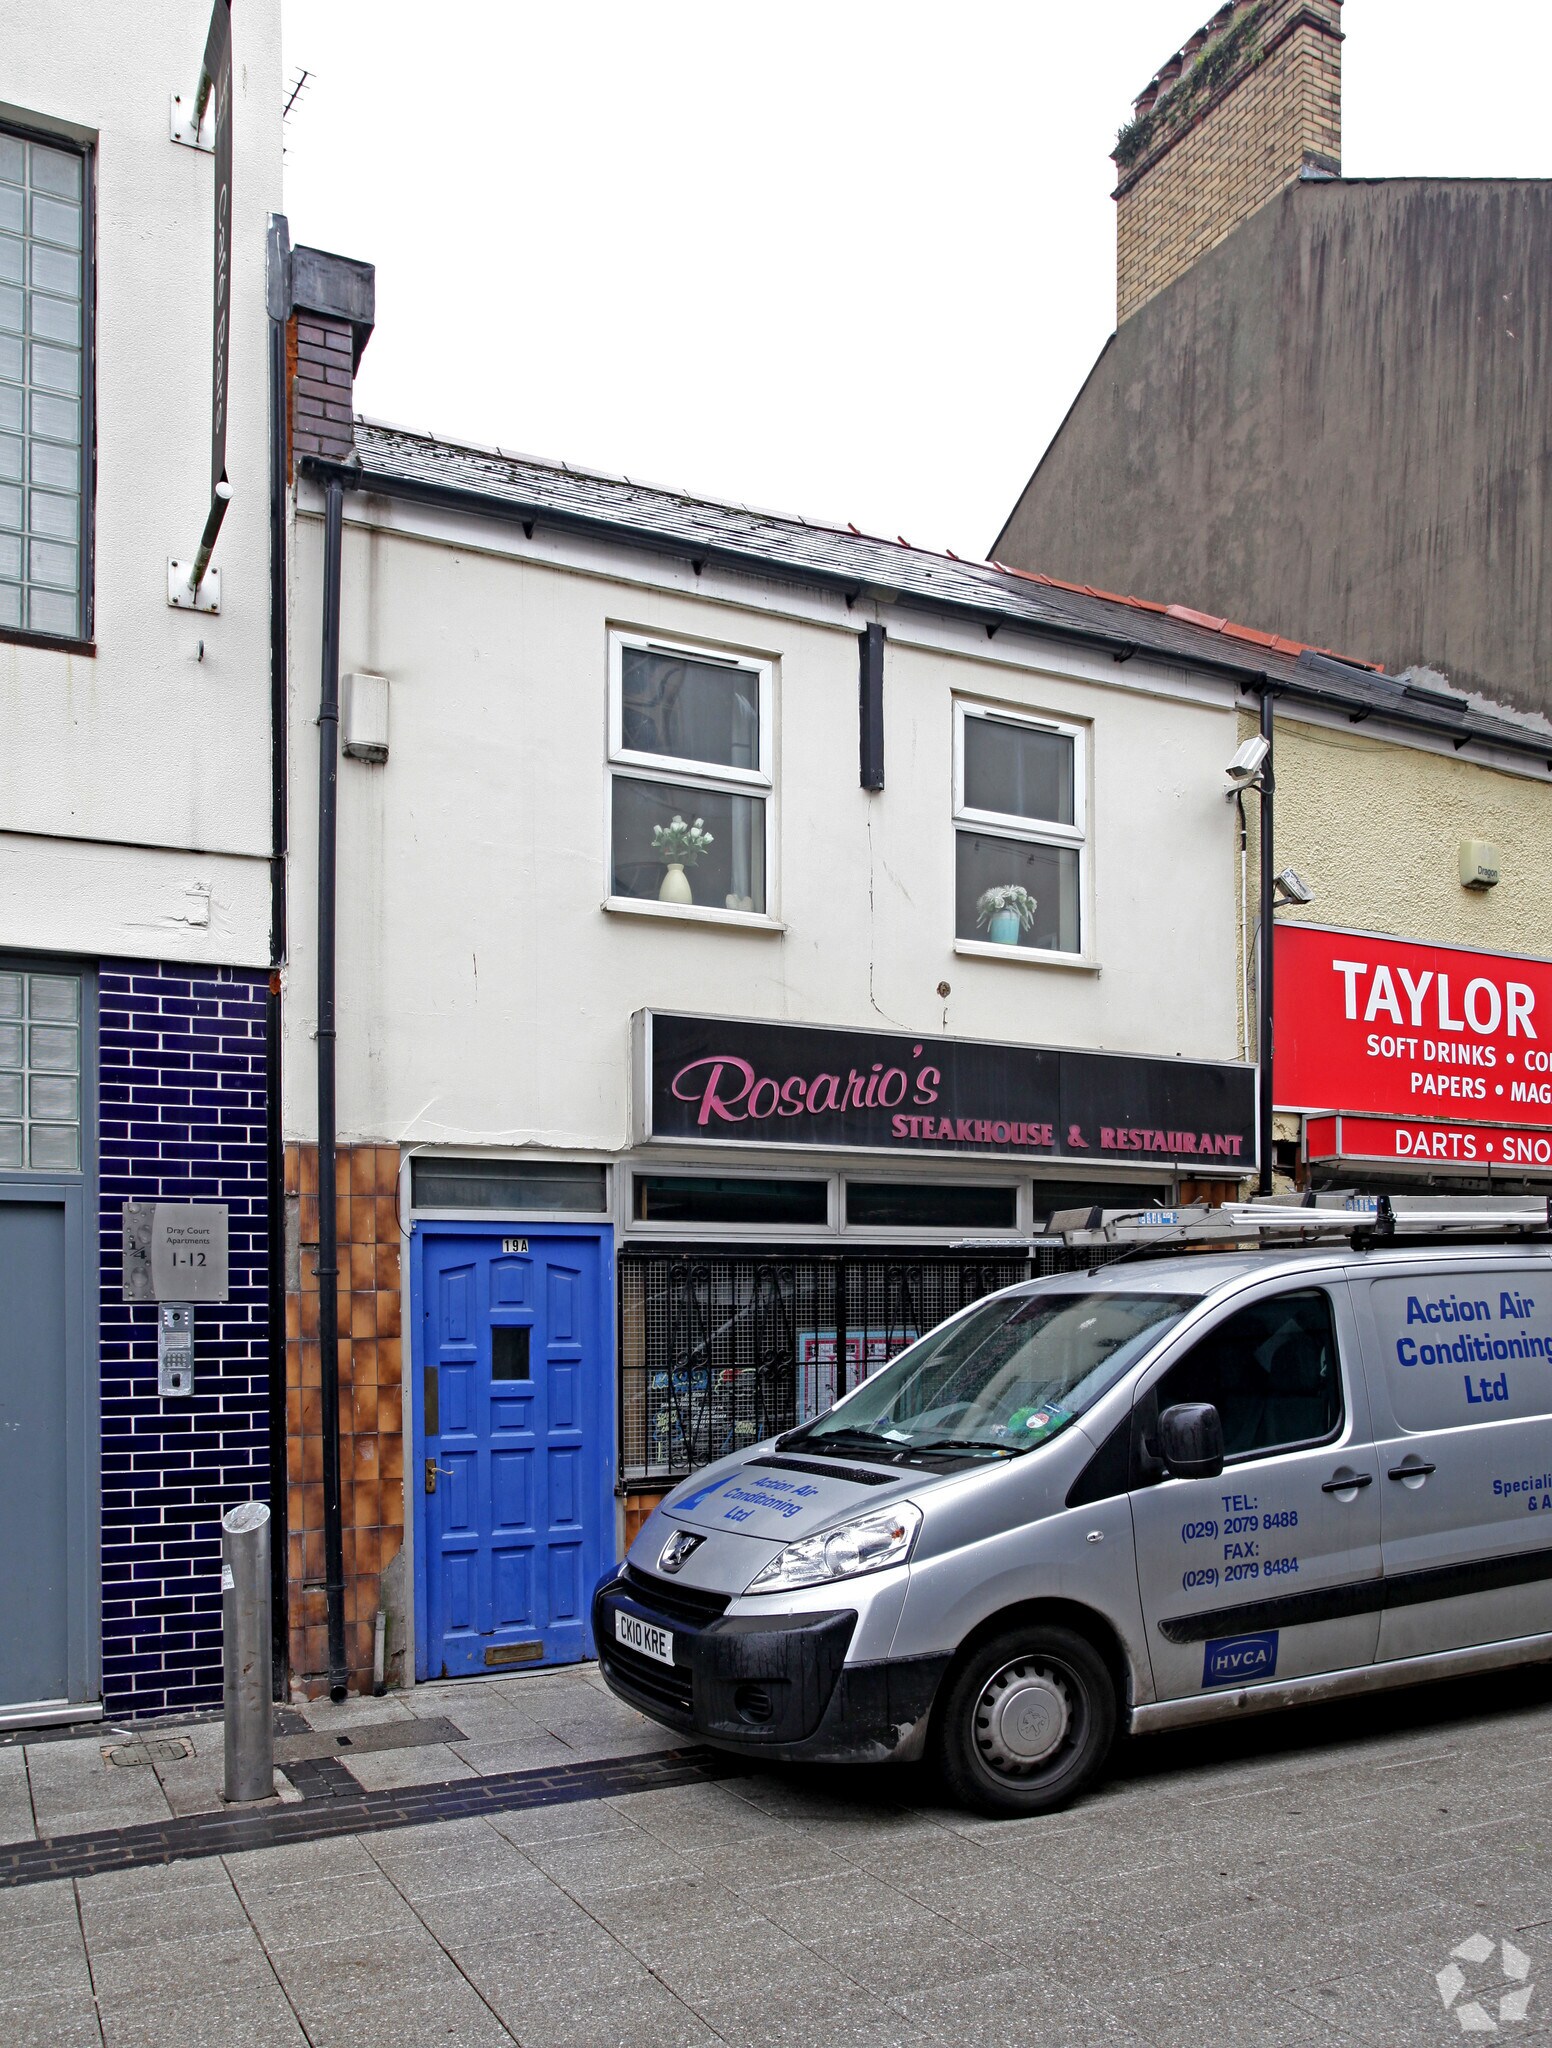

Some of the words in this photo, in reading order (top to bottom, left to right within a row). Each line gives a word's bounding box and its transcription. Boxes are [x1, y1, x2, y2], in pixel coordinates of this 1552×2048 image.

[1477, 865, 1498, 879] Dragon
[1332, 959, 1538, 1039] TAYLOR
[1366, 1033, 1419, 1061] SOFT
[1423, 1039, 1496, 1068] DRINKS
[671, 1043, 942, 1126] Rosario's
[1410, 1072, 1487, 1100] PAPERS
[891, 1113, 1055, 1147] STEAKHOUSE
[1067, 1124, 1090, 1149] &
[1099, 1126, 1243, 1157] RESTAURANT
[1395, 1129, 1477, 1159] DARTS
[166, 1227, 185, 1235] Dray
[187, 1227, 210, 1235] Court
[166, 1237, 210, 1245] Apartments
[173, 1252, 207, 1267] 1-12
[505, 1240, 528, 1252] 19A
[1406, 1295, 1490, 1325] Action
[1499, 1291, 1534, 1320] Air
[1464, 1373, 1509, 1404] Ltd
[750, 1477, 795, 1492] Action
[790, 1485, 819, 1497] Air
[722, 1487, 803, 1518] Conditioning
[723, 1505, 756, 1522] Ltd
[1222, 1493, 1258, 1512] TEL:
[1528, 1496, 1538, 1511] &
[1181, 1521, 1219, 1544] (029)
[1223, 1518, 1258, 1536] 2079
[1262, 1511, 1298, 1530] 8488
[1223, 1541, 1259, 1561] FAX:
[1182, 1567, 1220, 1590] (029)
[1224, 1563, 1259, 1582] 2079
[1263, 1557, 1299, 1576] 8484
[644, 1625, 667, 1658] KRE
[1216, 1648, 1267, 1672] HVCA
